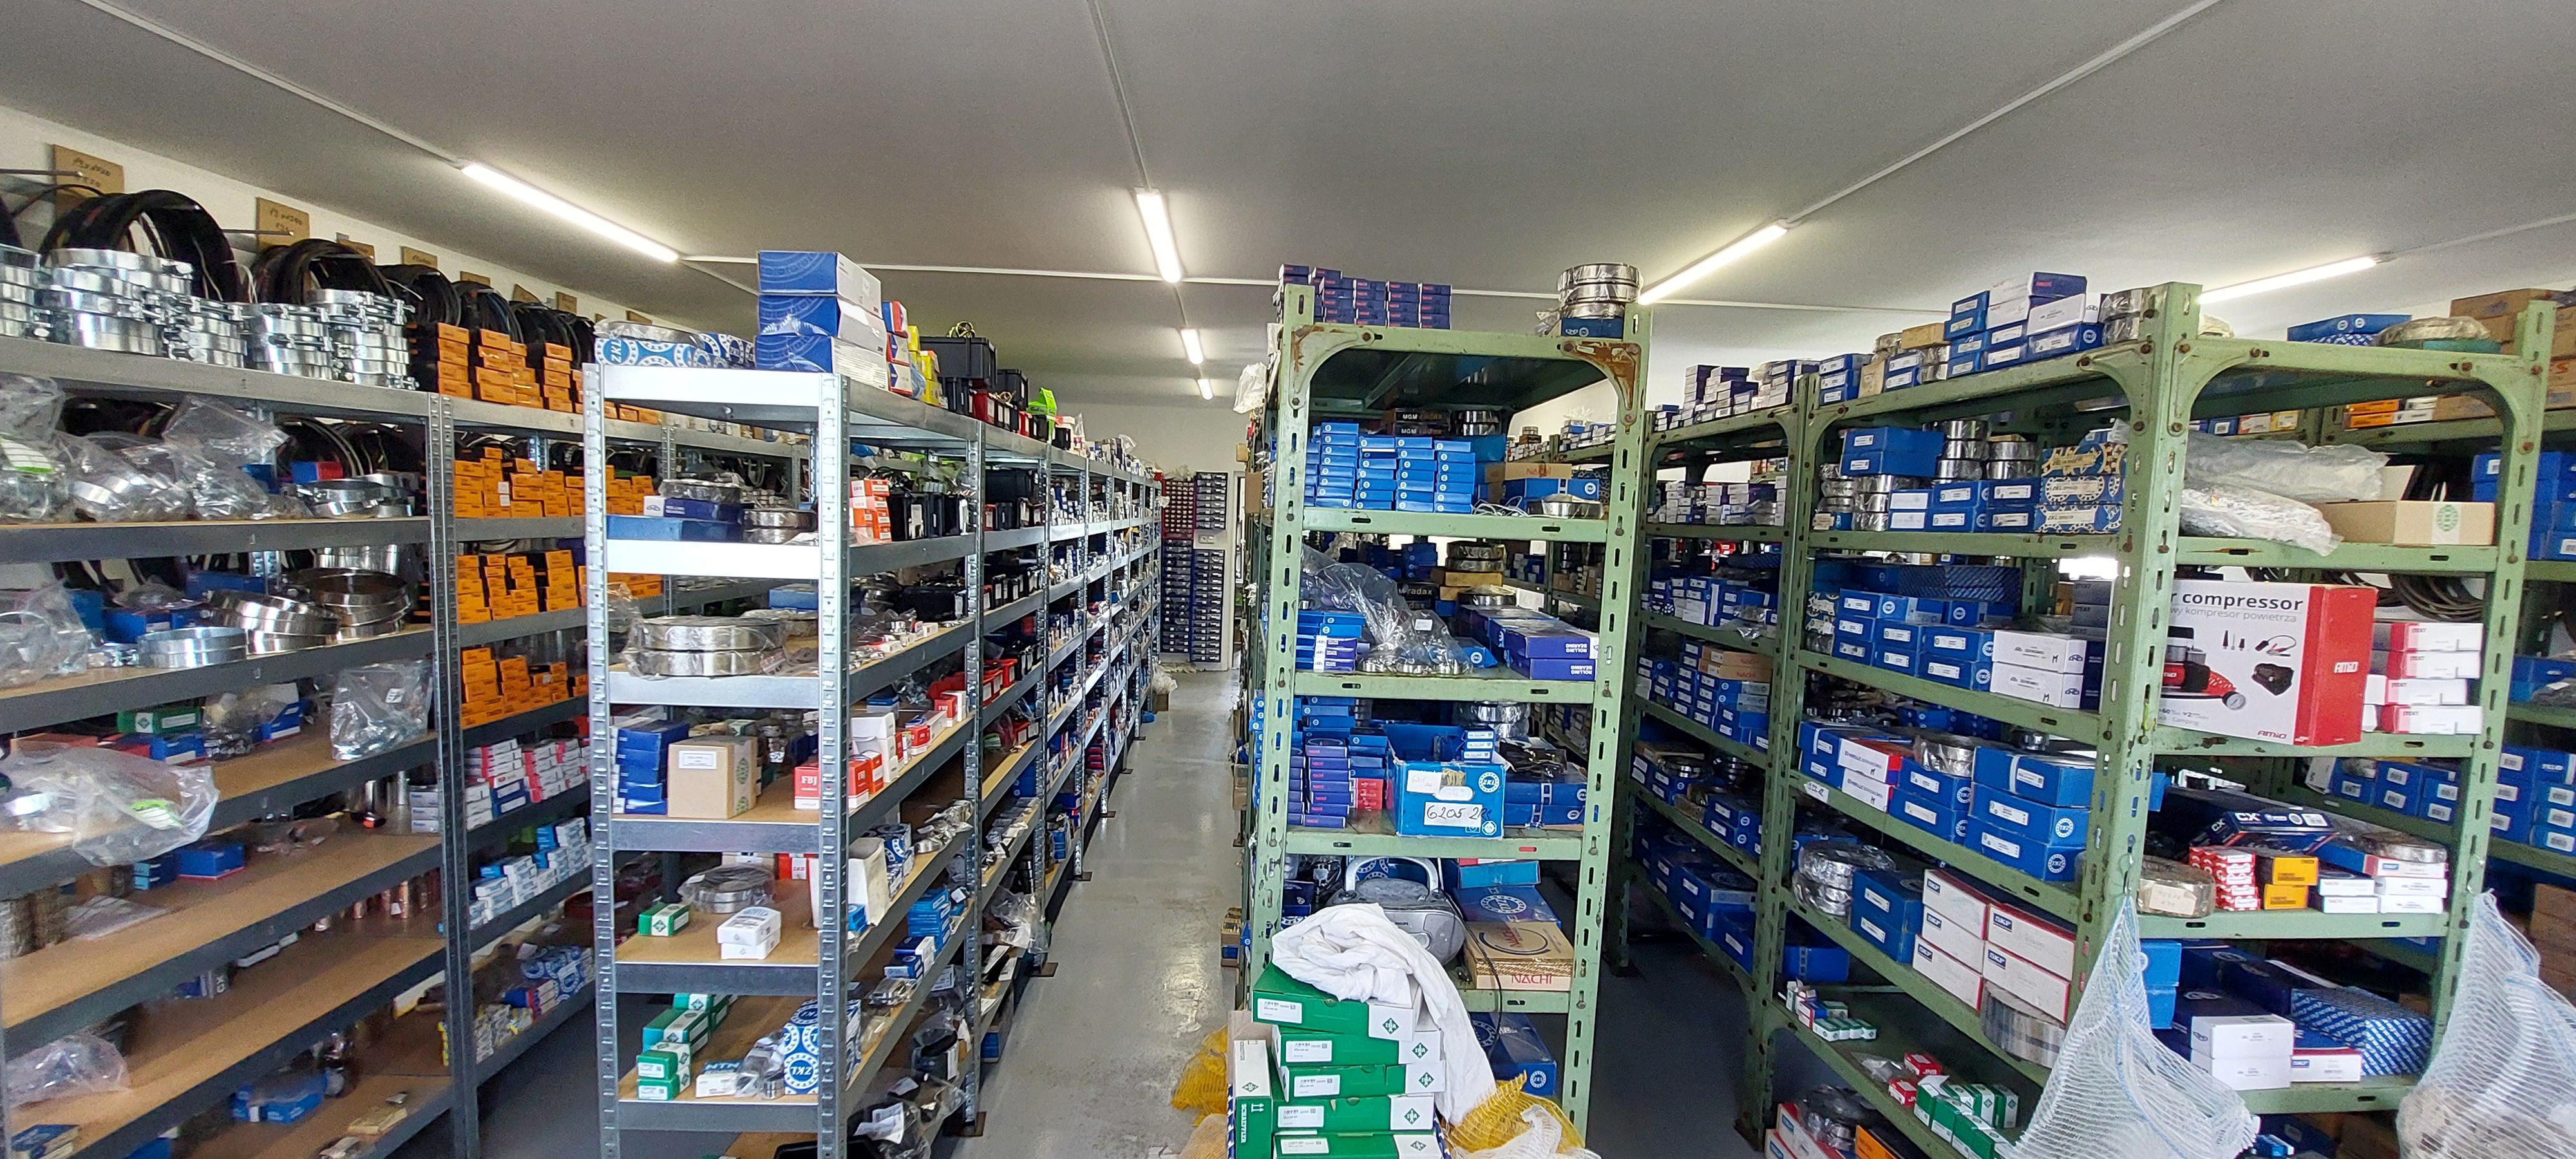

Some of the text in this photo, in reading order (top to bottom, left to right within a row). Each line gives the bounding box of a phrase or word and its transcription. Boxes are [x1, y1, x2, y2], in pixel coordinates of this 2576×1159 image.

[611, 339, 621, 363] ZKL
[2183, 593, 2304, 610] compressor
[2185, 607, 2240, 619] kompresor
[2243, 612, 2297, 623] powietrza
[801, 775, 817, 786] FBJ
[1426, 805, 1466, 820] 6205
[2234, 812, 2262, 822] CX
[2211, 818, 2226, 832] CX
[1994, 915, 2012, 927] SKF
[1989, 952, 2005, 963] SKF
[1511, 974, 1553, 985] NACHI
[789, 1066, 813, 1076] ZKL
